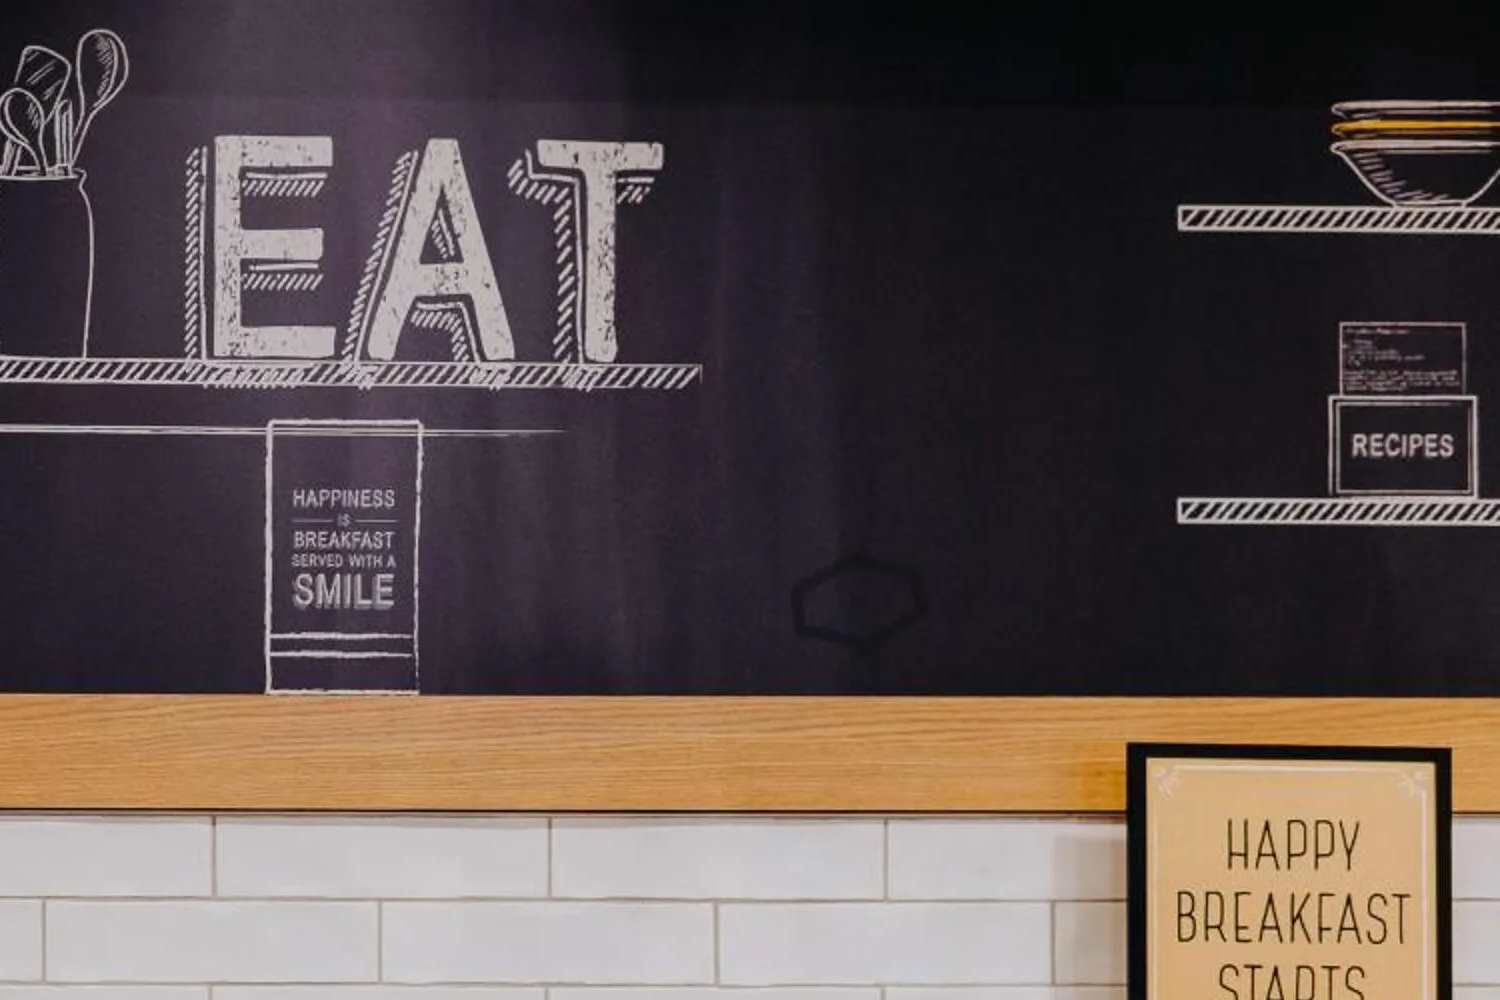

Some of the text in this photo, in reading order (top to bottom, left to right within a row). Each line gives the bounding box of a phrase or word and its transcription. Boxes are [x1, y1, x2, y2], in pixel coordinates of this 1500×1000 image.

[185, 135, 664, 366] EAT
[1351, 432, 1455, 458] RECIPES
[292, 488, 396, 509] HAPPINESS
[337, 512, 351, 527] IS
[293, 530, 397, 550] BREAKFAST
[291, 552, 397, 569] SERVED WITH A
[291, 572, 396, 611] SMILE
[1226, 818, 1360, 871] HAPPY
[1176, 890, 1412, 945] BREAKFAST
